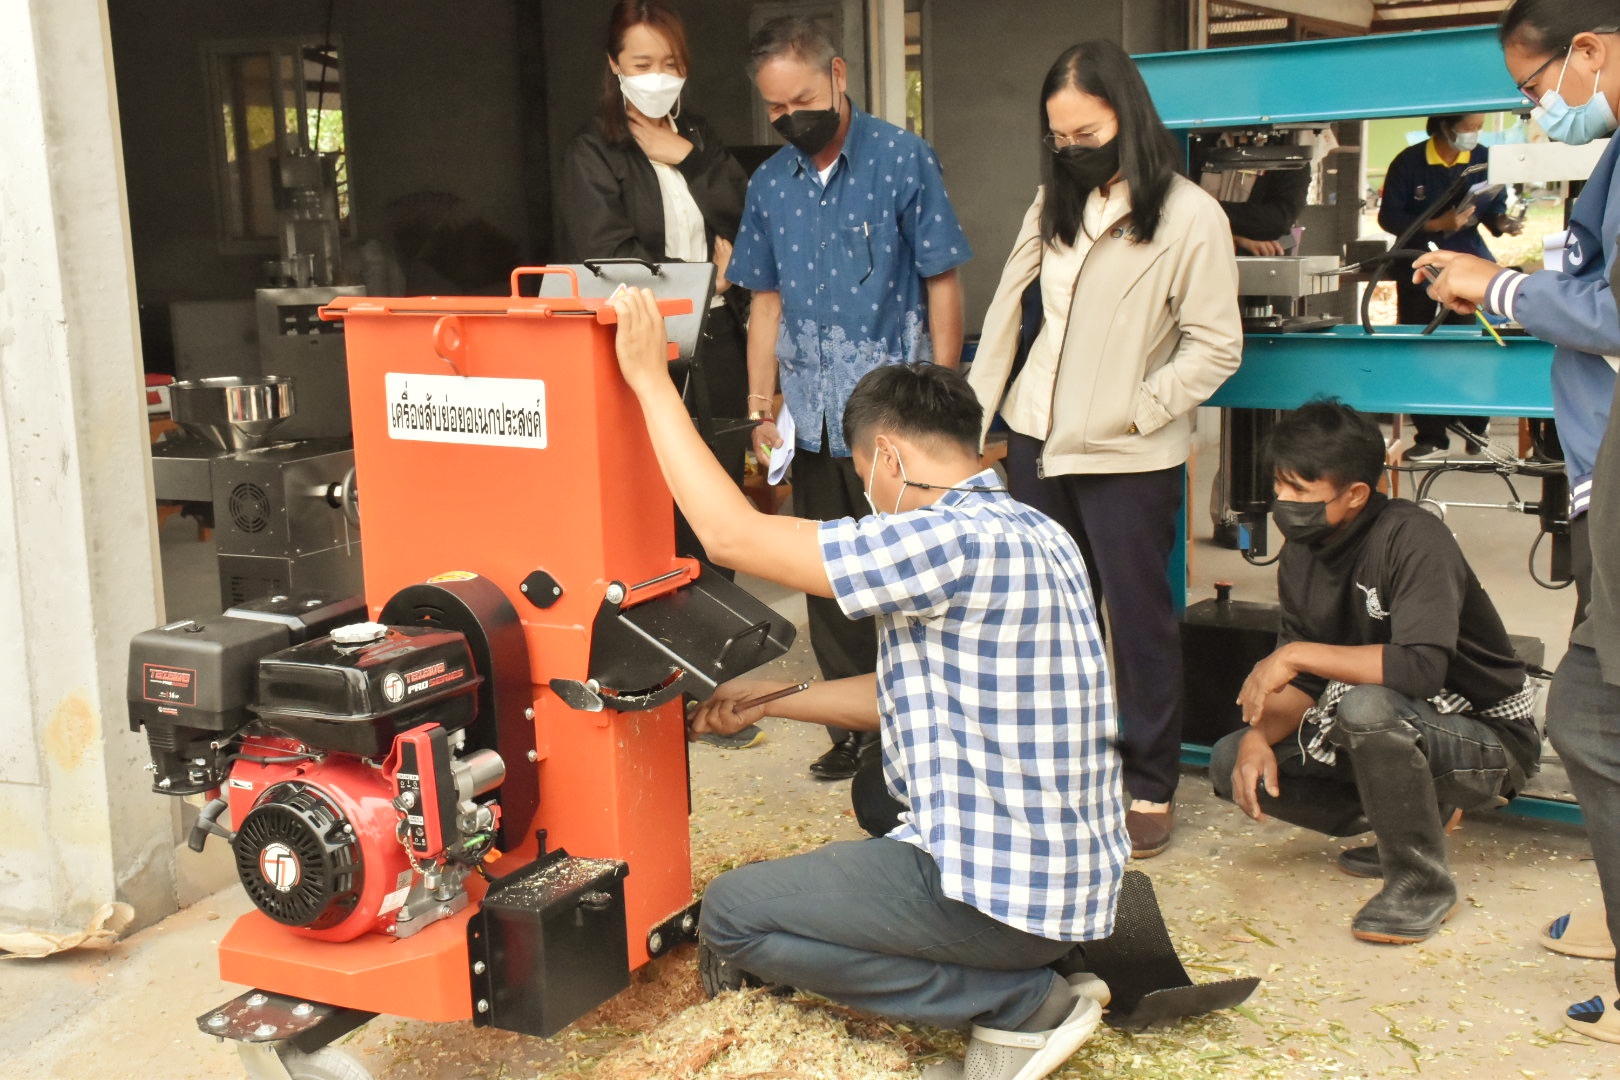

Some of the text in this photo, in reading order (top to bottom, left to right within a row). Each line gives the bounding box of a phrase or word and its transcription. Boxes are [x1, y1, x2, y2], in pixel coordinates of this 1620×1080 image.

[391, 381, 542, 438] เครื่องสับย่อยอเนกประสงค์
[408, 680, 428, 694] PRO
